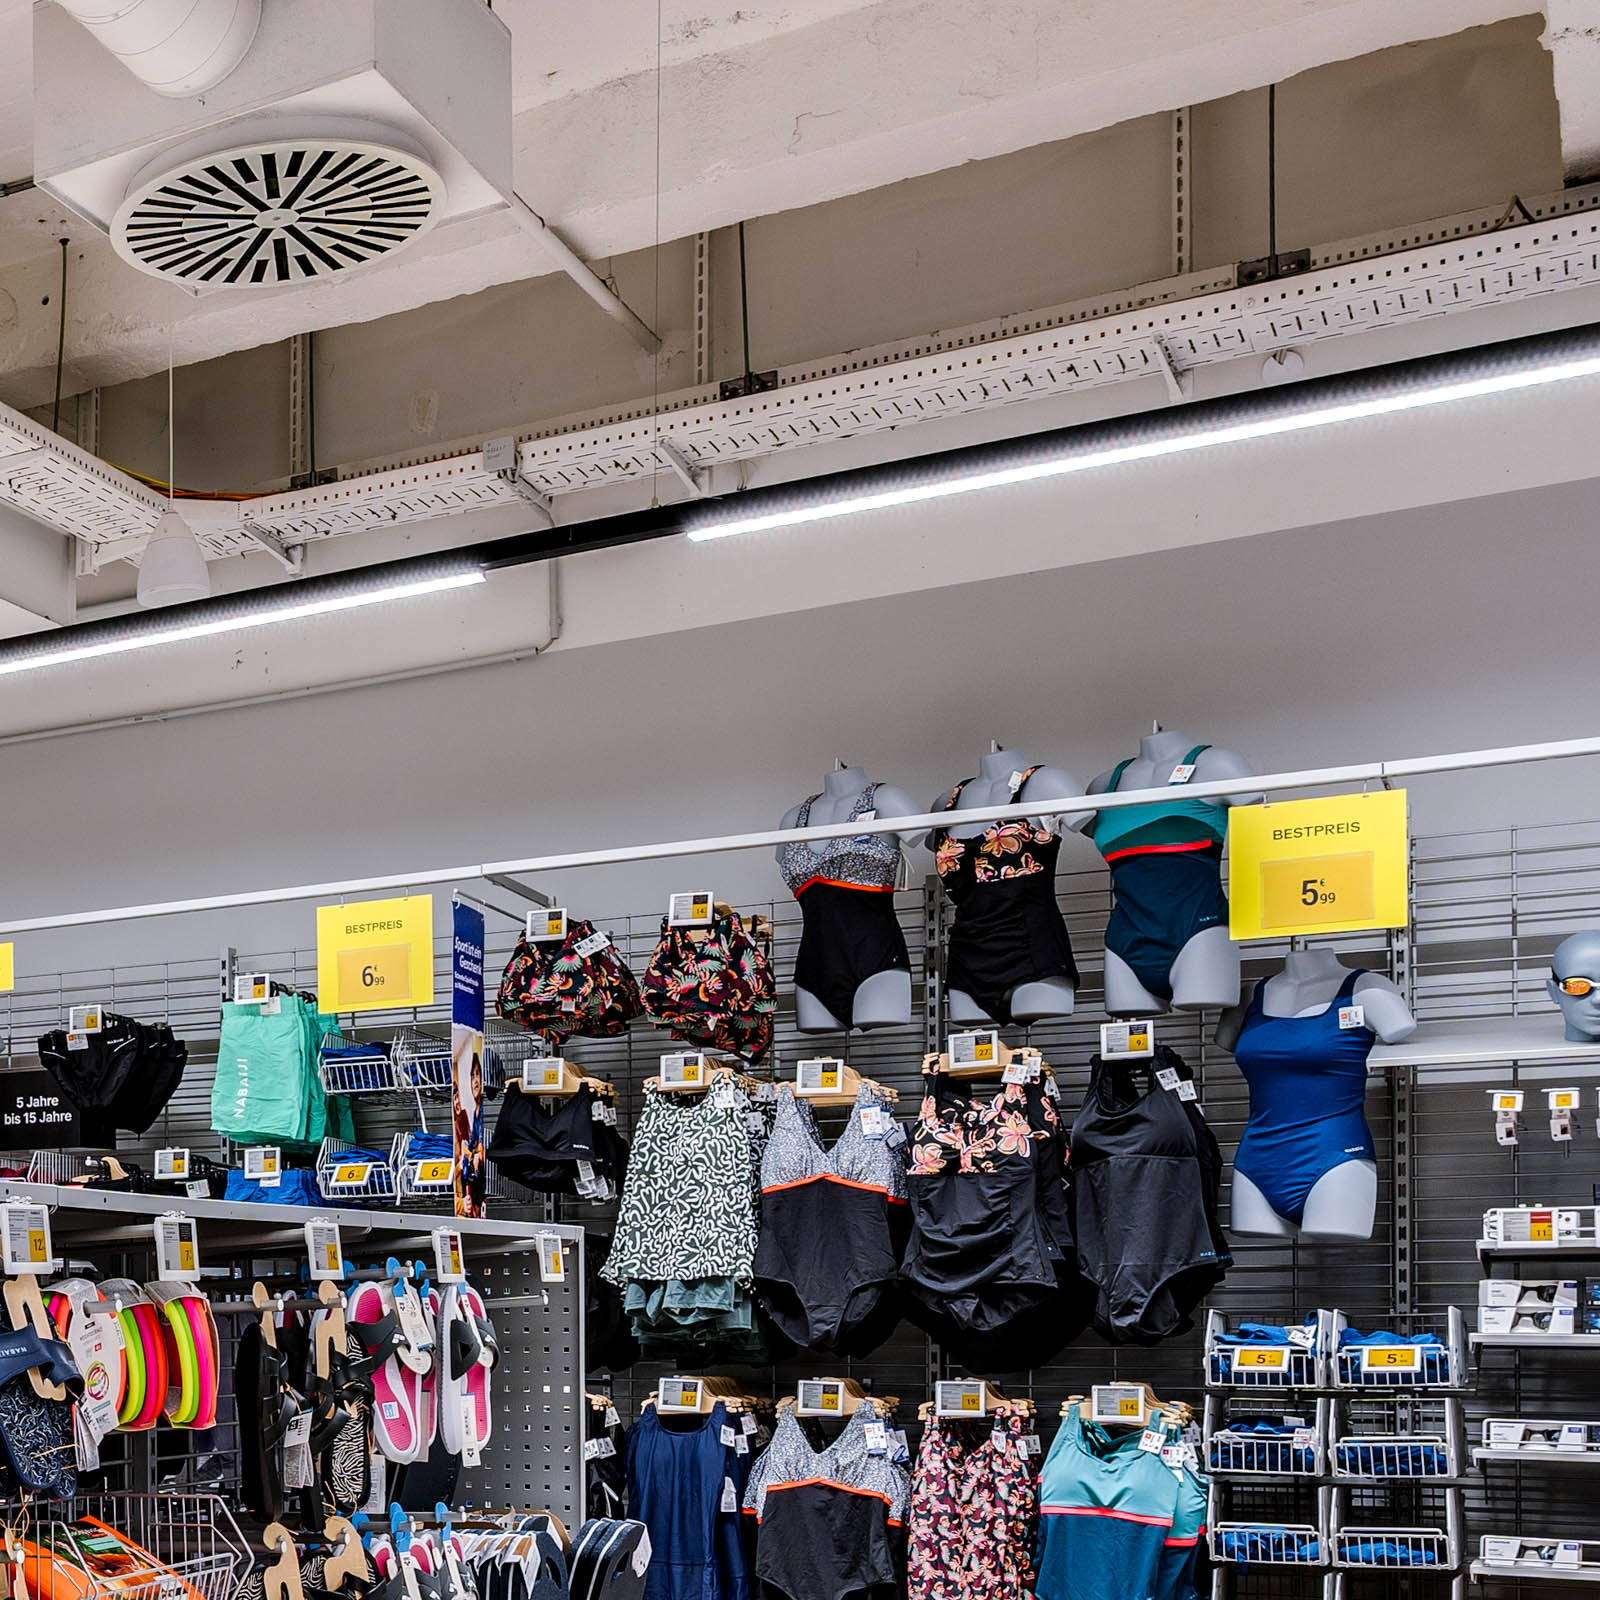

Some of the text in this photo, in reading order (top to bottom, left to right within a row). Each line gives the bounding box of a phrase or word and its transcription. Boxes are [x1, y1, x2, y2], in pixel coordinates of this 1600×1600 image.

[1273, 821, 1361, 841] BESTPREIS
[345, 919, 403, 935] BESTPREIS
[233, 1057, 249, 1118] NABAIJI
[16, 1095, 60, 1109] 5 Jahre
[4, 1110, 73, 1125] bis 15 Jahre
